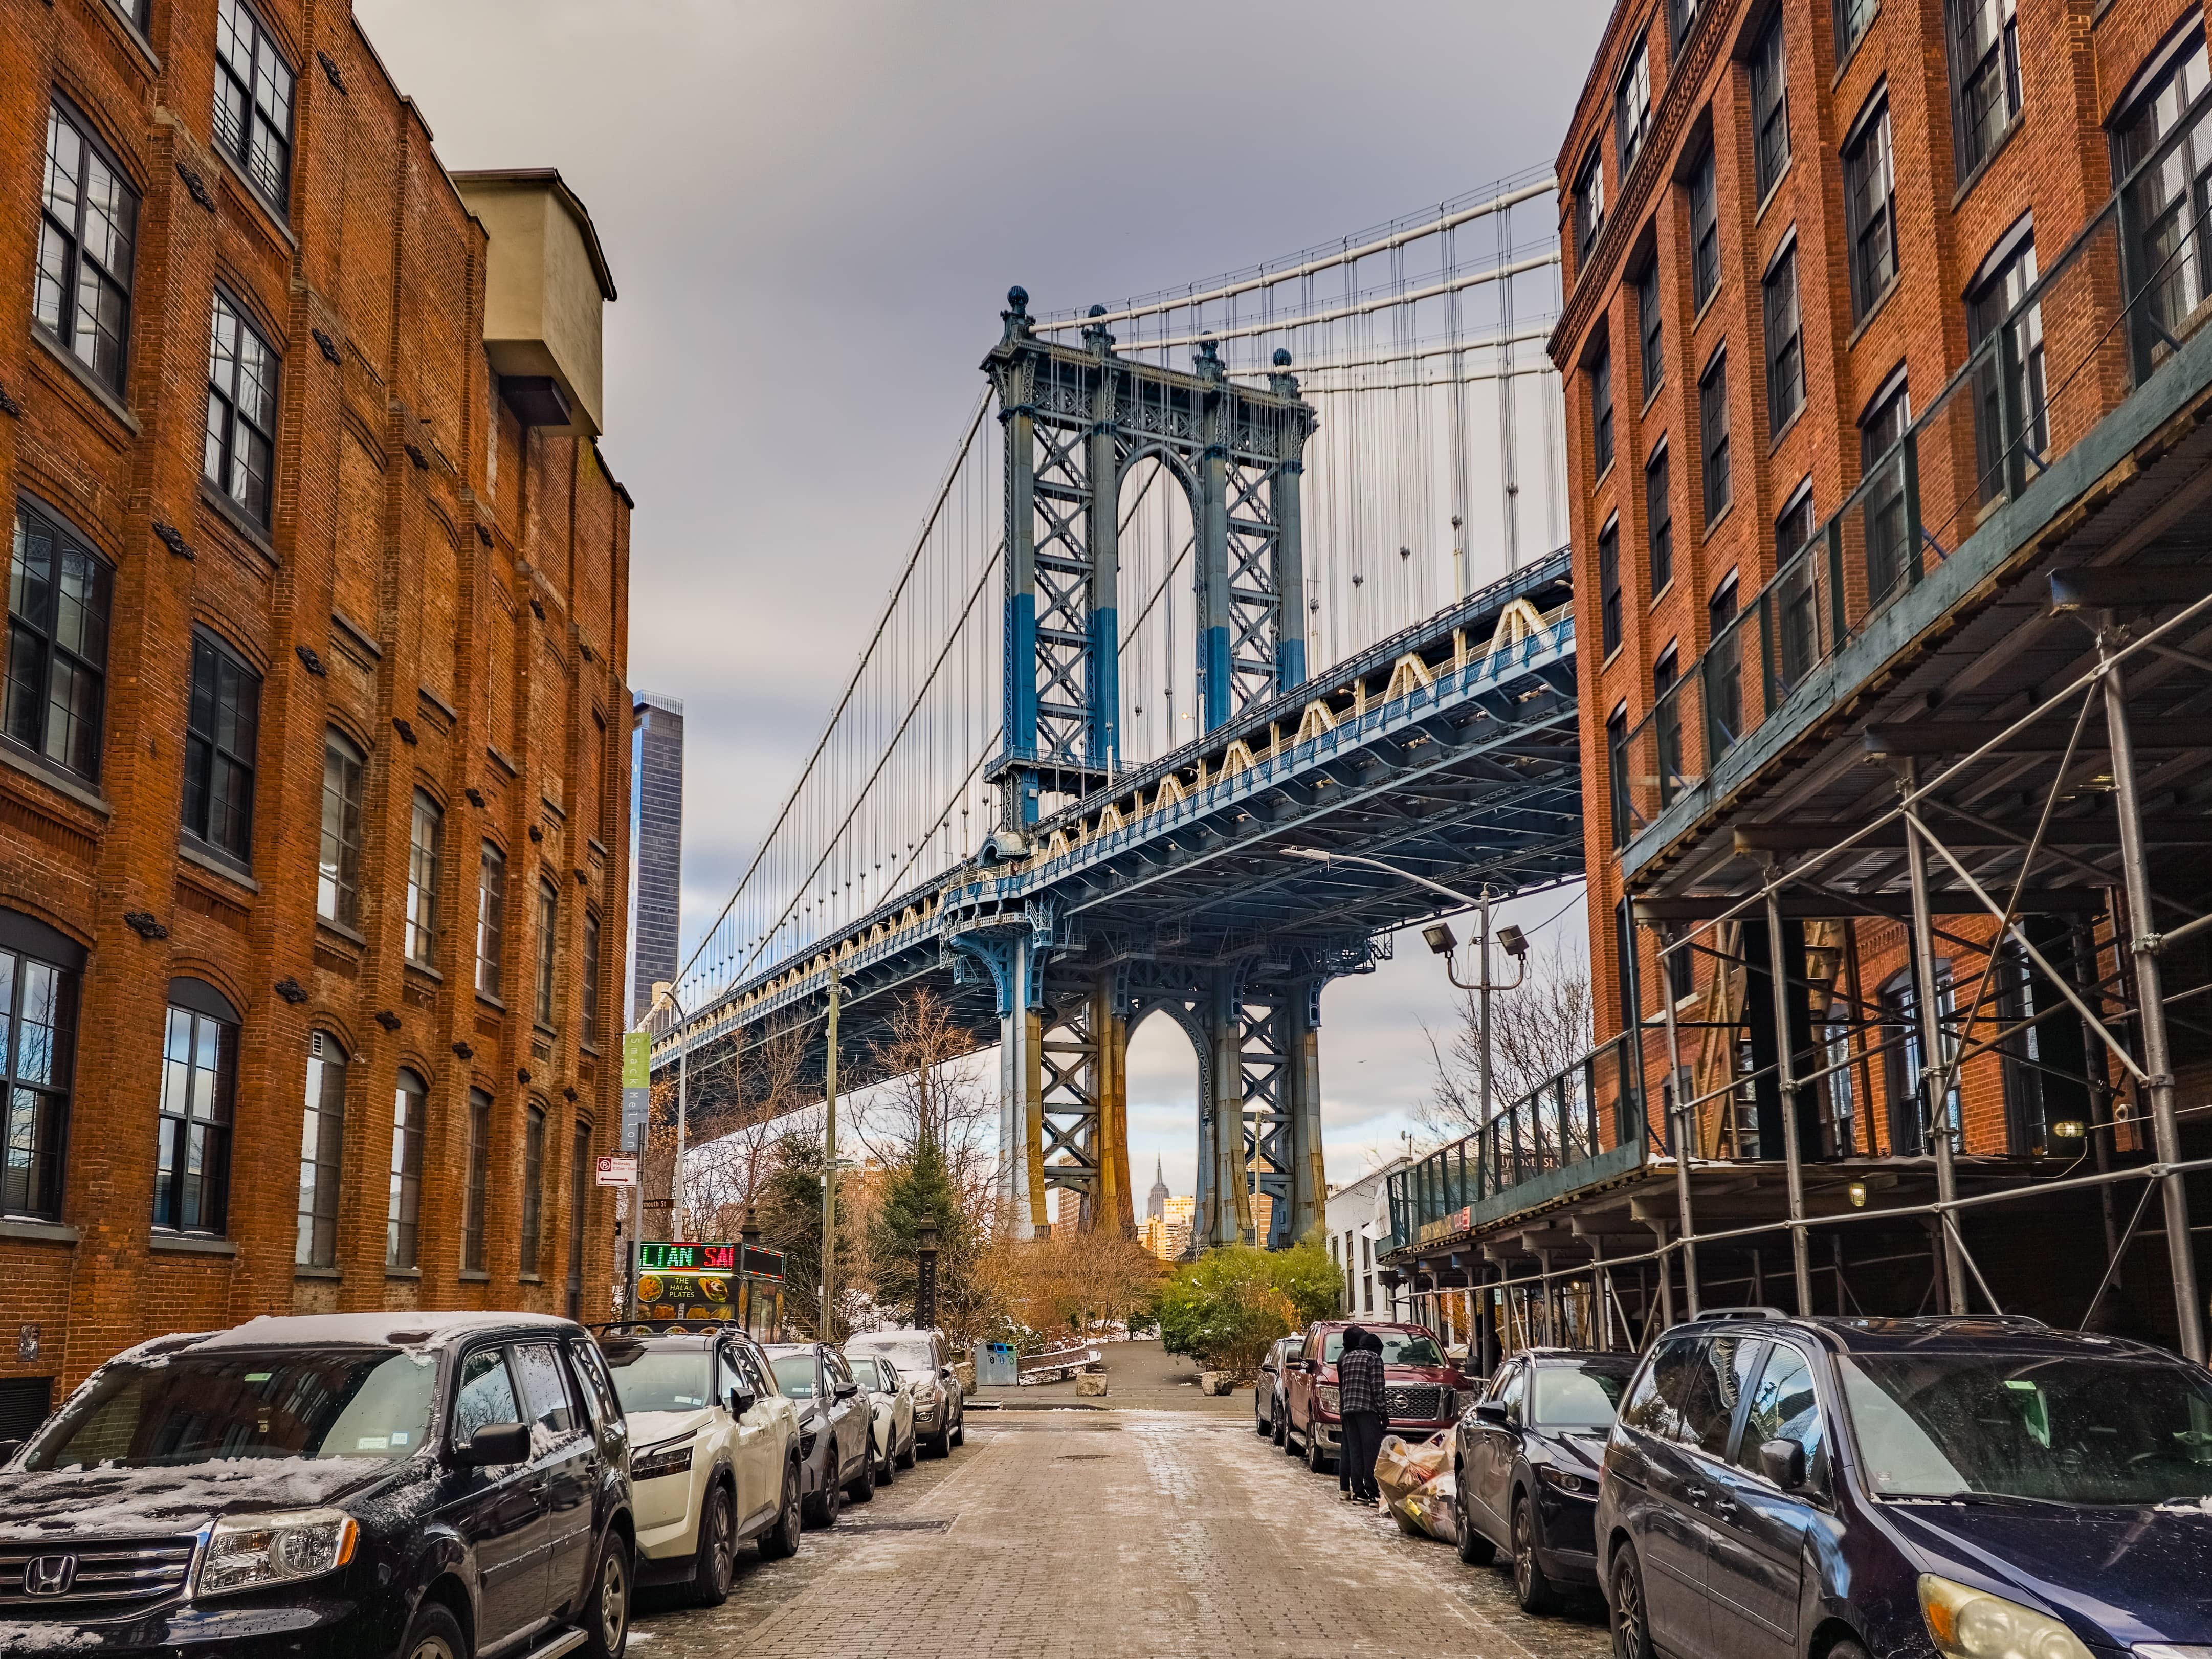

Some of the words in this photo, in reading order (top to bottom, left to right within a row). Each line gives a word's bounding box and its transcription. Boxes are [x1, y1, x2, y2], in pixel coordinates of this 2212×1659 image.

[630, 1038, 640, 1085] Smack
[627, 1092, 638, 1147] Mellon
[1543, 1157, 1553, 1167] St
[639, 1247, 692, 1266] LIAN
